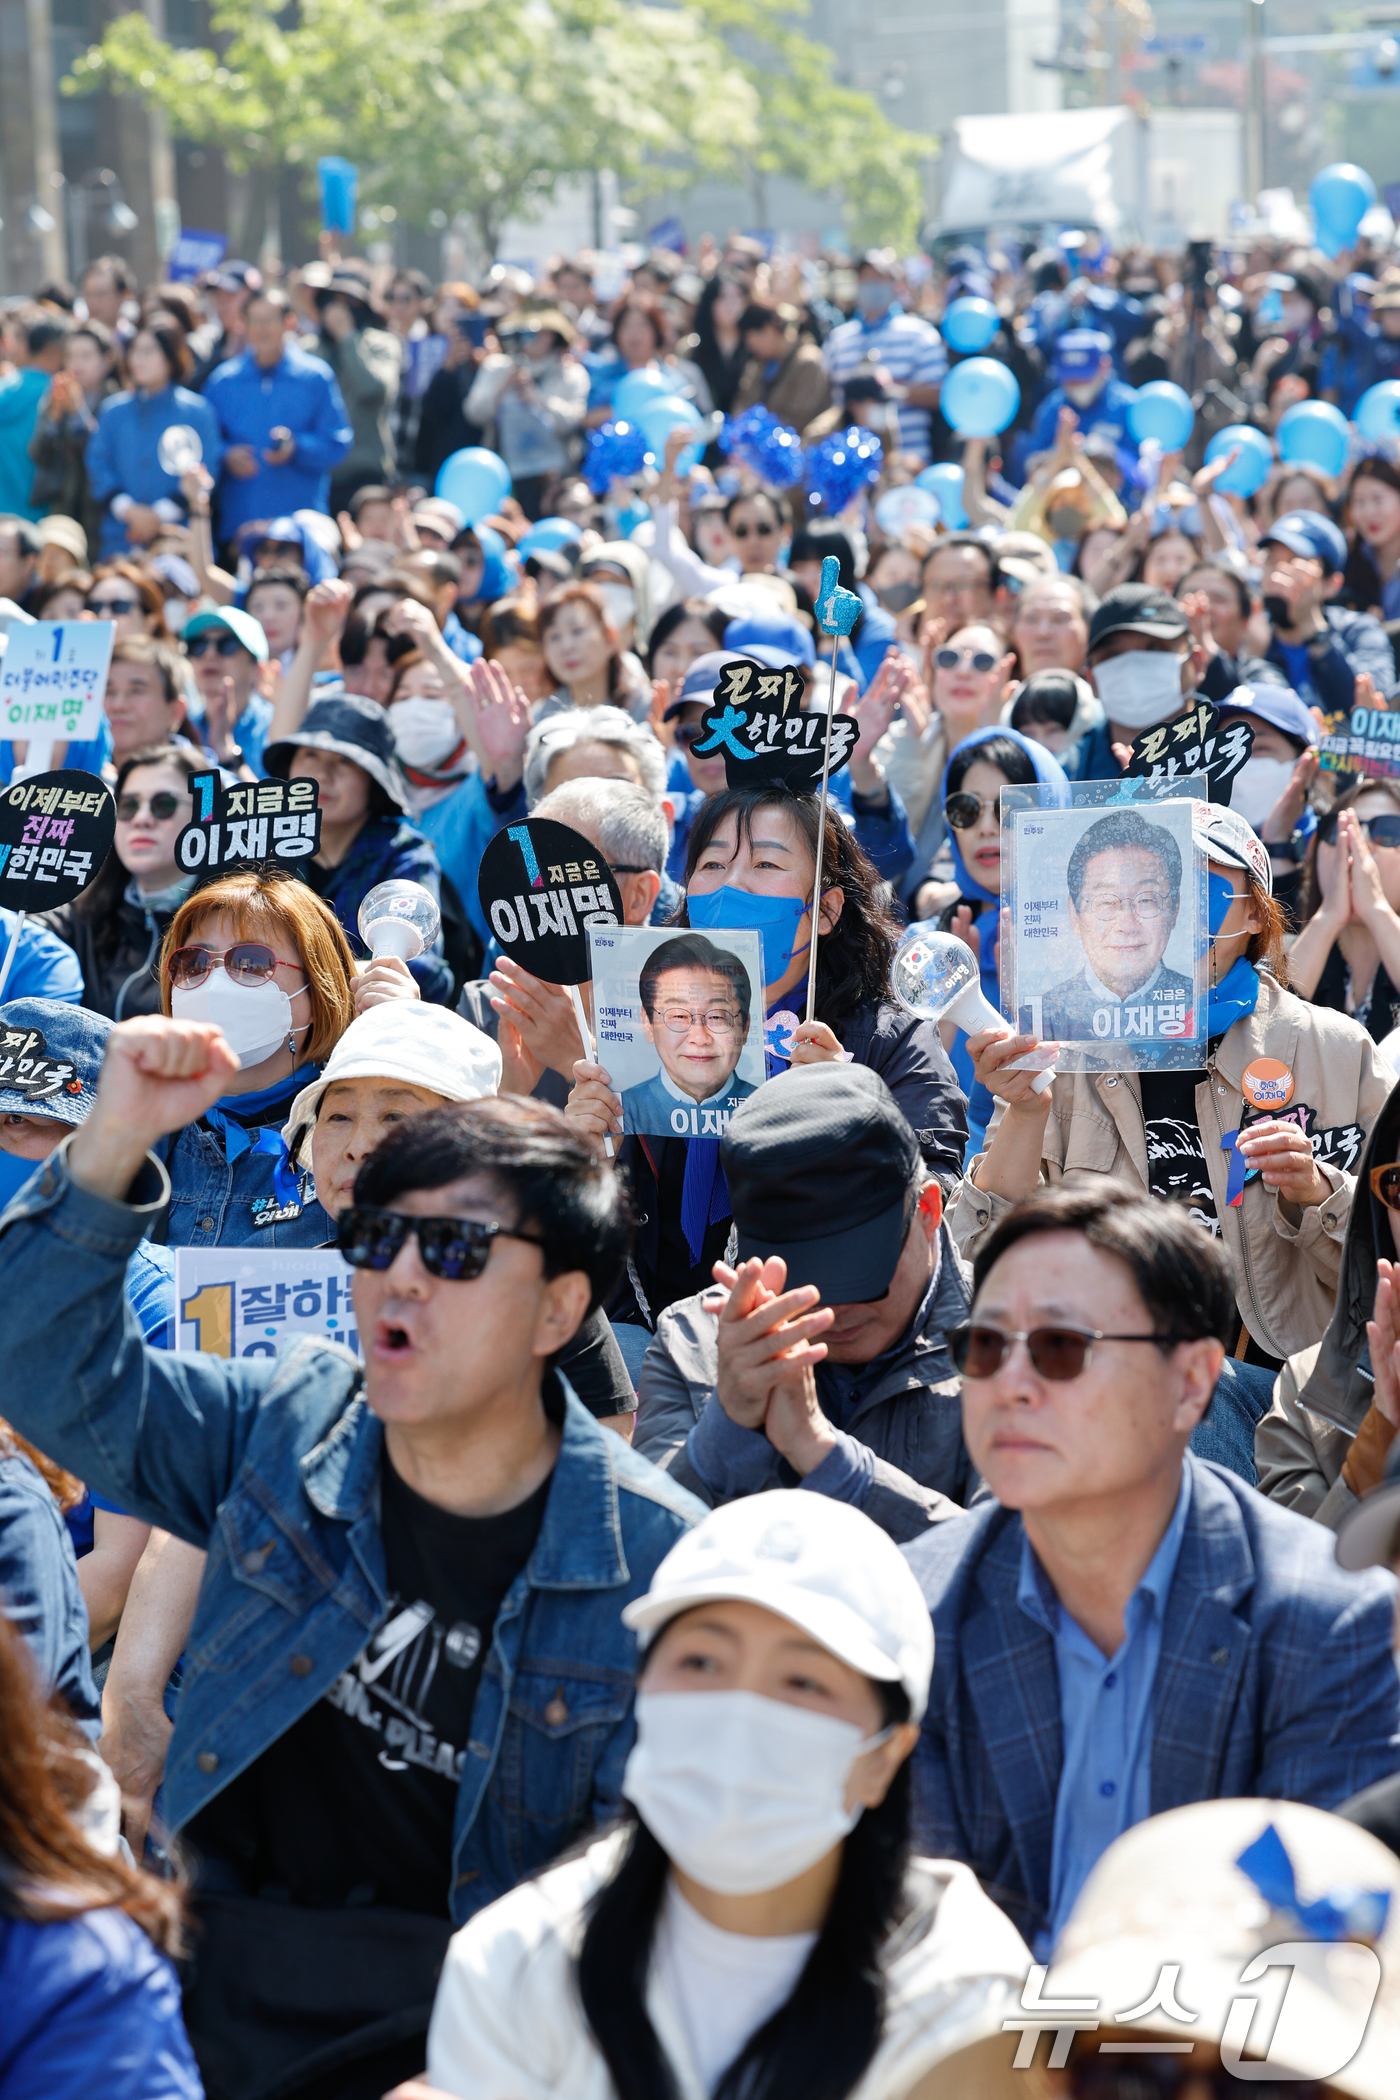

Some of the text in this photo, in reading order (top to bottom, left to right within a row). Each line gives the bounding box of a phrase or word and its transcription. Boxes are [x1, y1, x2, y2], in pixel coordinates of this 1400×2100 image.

[822, 596, 838, 627] 1
[52, 627, 63, 662] 1
[720, 666, 800, 718] 진짜
[1136, 705, 1213, 763] 진짜
[8, 784, 108, 817] 이제부터
[194, 775, 214, 822] 1
[226, 782, 315, 817] 지금은
[21, 815, 75, 846] 진짜
[181, 812, 317, 868] 이재명
[507, 825, 544, 888] 1
[547, 859, 601, 884] 지금은
[490, 883, 619, 943] 이재명
[1023, 899, 1059, 912] 이제부터
[1023, 914, 1041, 925] 진짜
[1023, 926, 1059, 938] 대한민국
[1152, 988, 1187, 1001] 지금은
[599, 1007, 633, 1018] 이제부터
[600, 1019, 617, 1029] 진짜
[1024, 995, 1043, 1041] 1
[1092, 1003, 1187, 1038] 이재명
[600, 1031, 634, 1042] 대한민국
[1253, 1090, 1286, 1102] 이재명
[180, 1281, 236, 1359] 1
